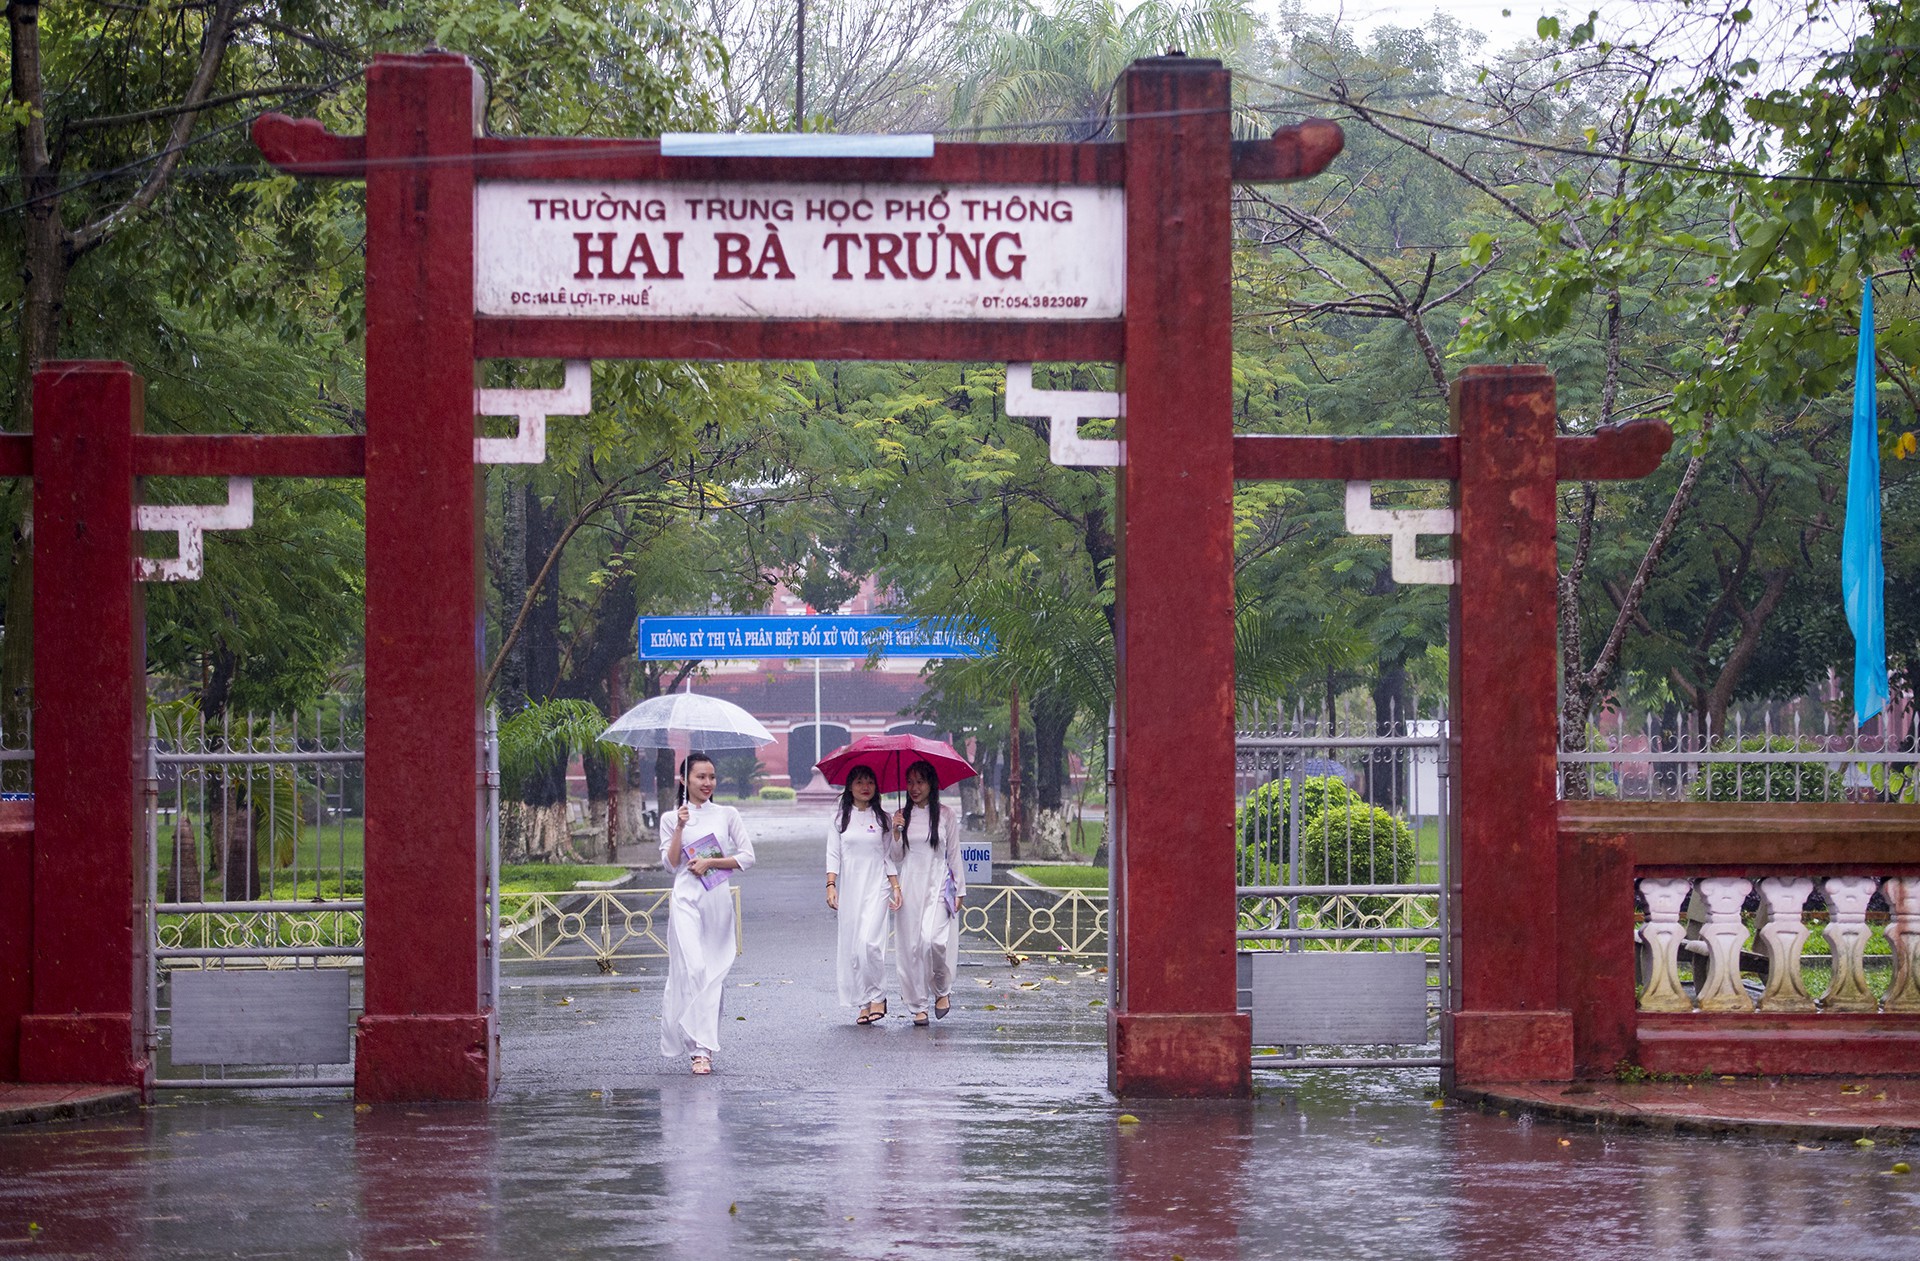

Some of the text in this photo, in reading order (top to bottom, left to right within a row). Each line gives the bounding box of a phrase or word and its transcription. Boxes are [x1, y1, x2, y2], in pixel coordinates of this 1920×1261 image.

[528, 189, 1073, 227] TRƯỜNG TRUNG HỌC PHỔ THÔNG
[573, 222, 1027, 281] HAI BÀ TRƯNG
[650, 629, 688, 648] KHÔNG
[689, 628, 705, 647] KỲ
[707, 632, 725, 650] THỊ
[728, 628, 743, 647] VÀ
[745, 628, 773, 647] PHÂN
[775, 628, 800, 650] BIỆT
[802, 624, 821, 646] ĐỐI
[823, 626, 839, 646] XỬ
[840, 626, 859, 646] VỚI
[968, 863, 978, 872] XE
